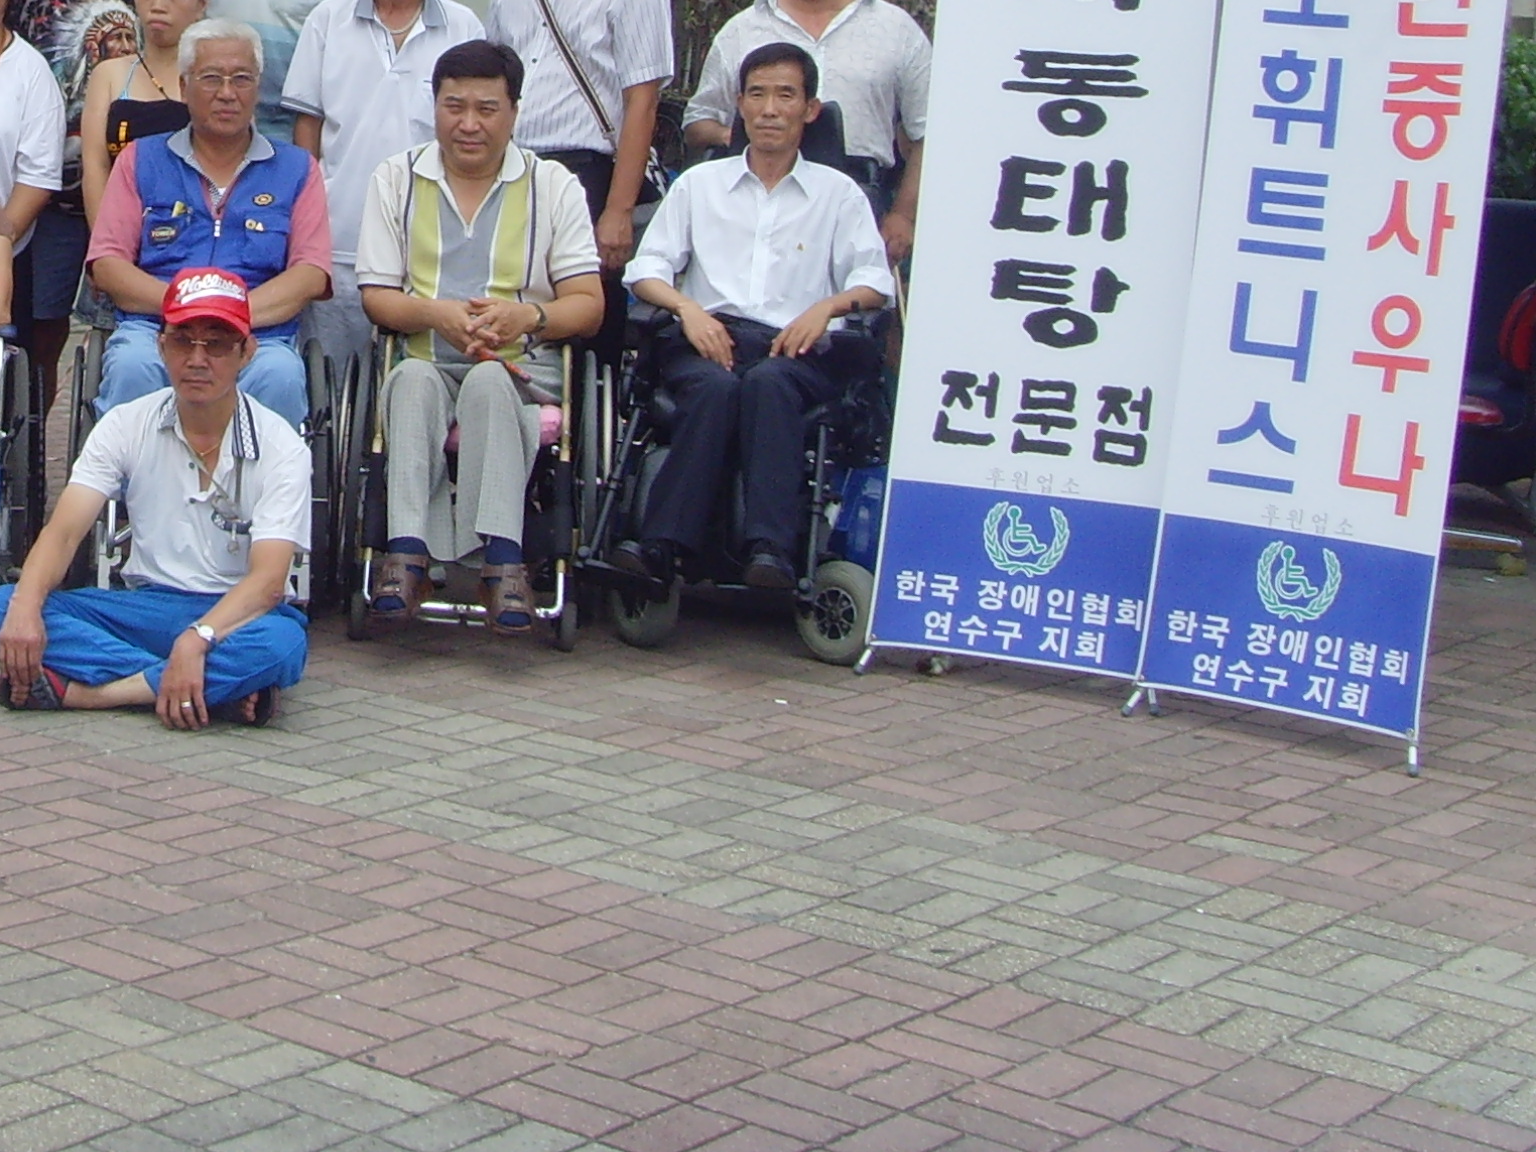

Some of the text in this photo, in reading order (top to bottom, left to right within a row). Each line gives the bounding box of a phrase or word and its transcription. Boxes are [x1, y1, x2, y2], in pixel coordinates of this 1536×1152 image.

[931, 369, 1153, 467] 전문점
[985, 466, 1081, 496] 후원업소
[1260, 504, 1354, 537] 후원업소
[895, 569, 1145, 633] 한국 장애인협회
[923, 610, 1106, 665] 연수구 지회
[1167, 609, 1410, 686] 한국 장애인협회
[1191, 652, 1371, 719] 연수구 지회
